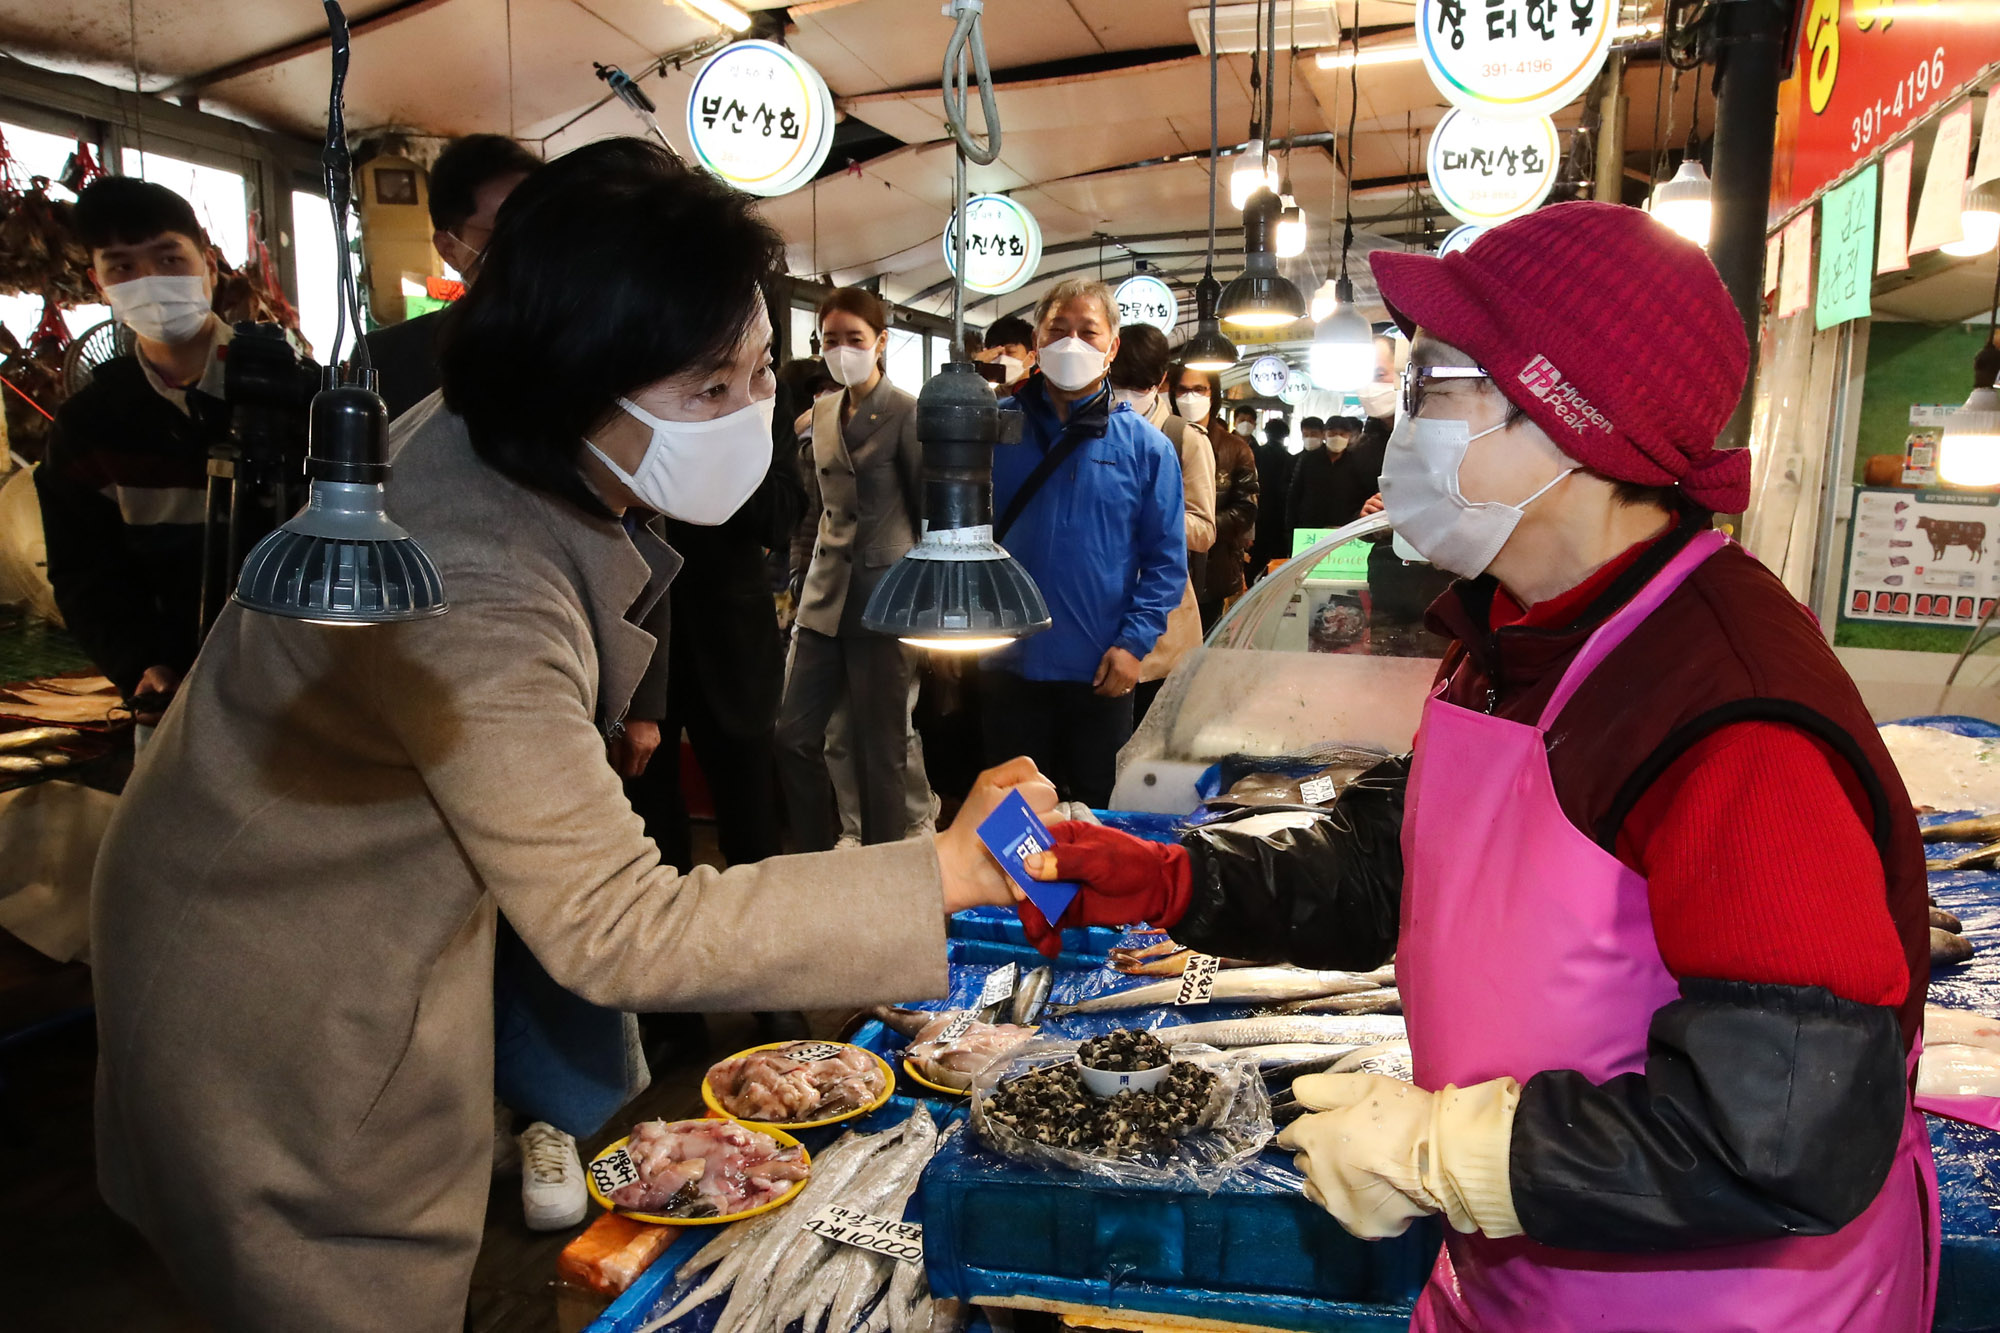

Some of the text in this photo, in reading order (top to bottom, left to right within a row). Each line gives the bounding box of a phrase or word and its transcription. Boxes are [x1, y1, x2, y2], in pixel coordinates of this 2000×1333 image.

[1482, 59, 1553, 78] 391-4196
[702, 96, 799, 139] 부산상회
[1851, 46, 1945, 152] 391-4196
[1442, 144, 1544, 177] 대진상회
[1543, 393, 1588, 435] Peak
[1554, 381, 1614, 435] Hidden
[1177, 972, 1197, 1004] 5000
[591, 1159, 615, 1192] 6000
